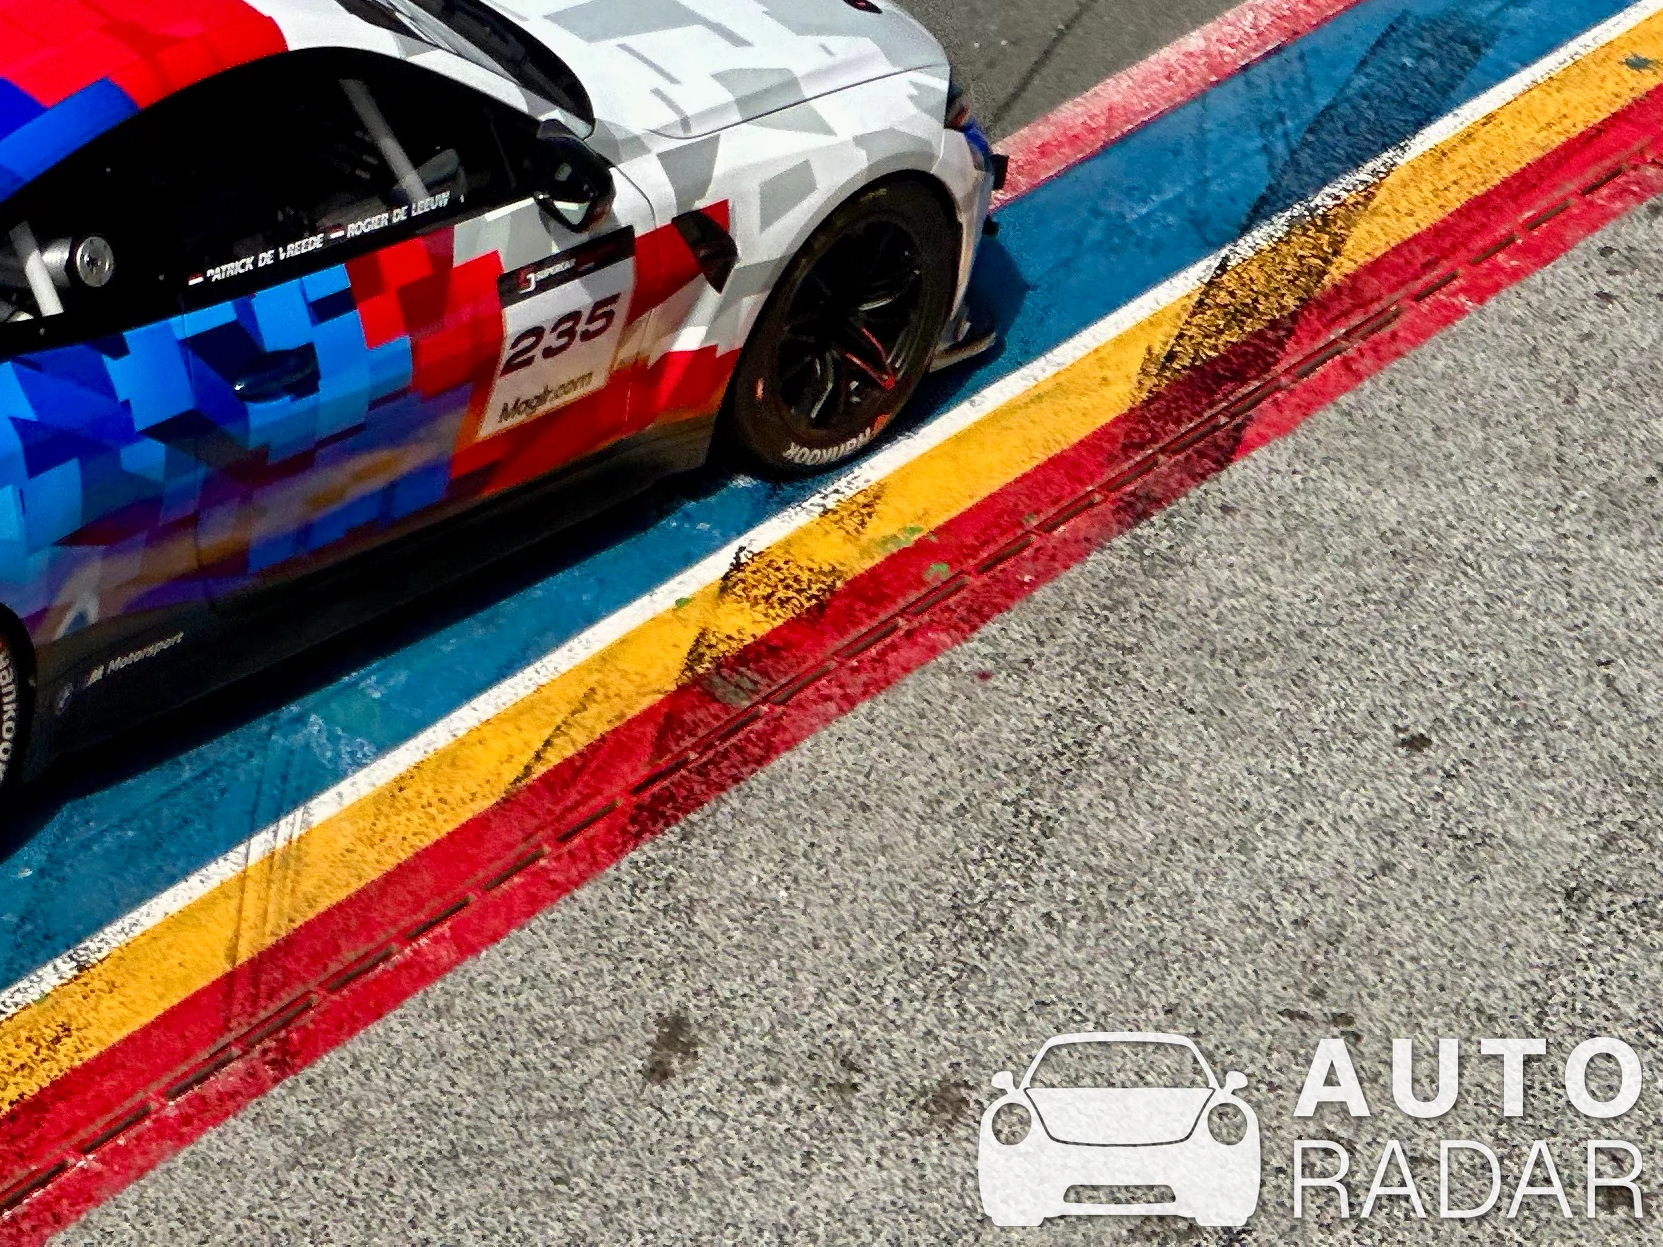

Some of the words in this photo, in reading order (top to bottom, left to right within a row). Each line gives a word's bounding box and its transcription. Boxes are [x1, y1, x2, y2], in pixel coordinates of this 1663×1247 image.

[346, 213, 390, 240] ROGIER
[391, 206, 409, 224] DE
[257, 249, 275, 267] DE
[499, 292, 622, 378] 235
